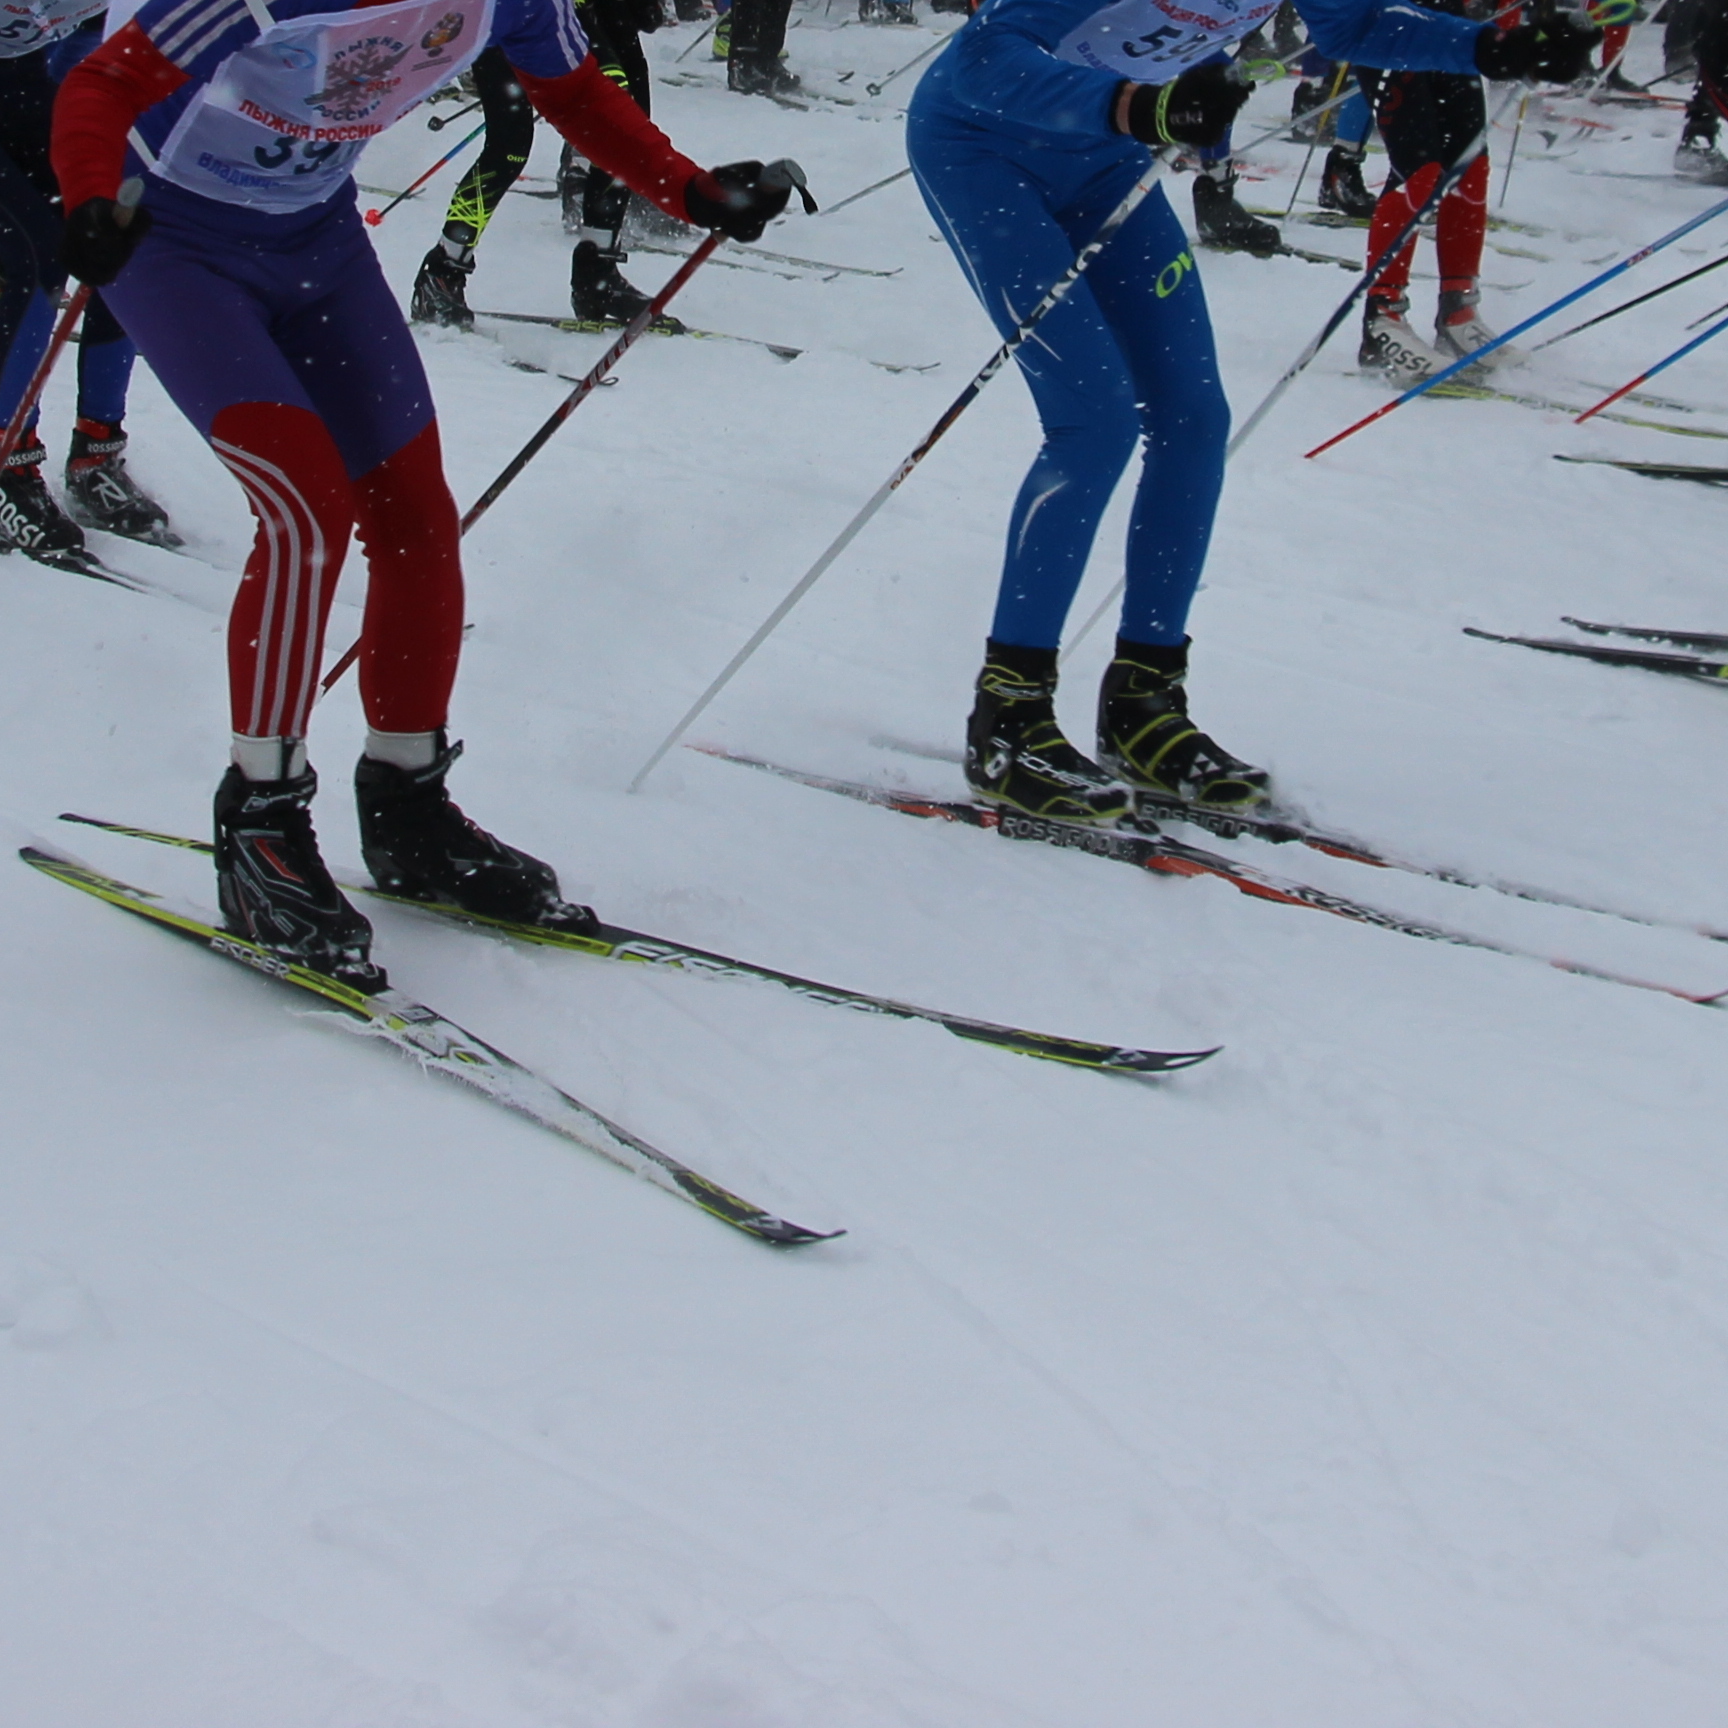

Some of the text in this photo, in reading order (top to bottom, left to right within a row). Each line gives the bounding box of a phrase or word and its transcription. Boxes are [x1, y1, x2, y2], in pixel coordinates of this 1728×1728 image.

[333, 35, 405, 60] ЛЫЖНЯ
[238, 99, 385, 143] ЛЫЖНЯ РОССИИ
[1374, 331, 1433, 375] ROSSI
[1001, 816, 1118, 860] ROSSIGNOL
[210, 935, 291, 980] FISCHER
